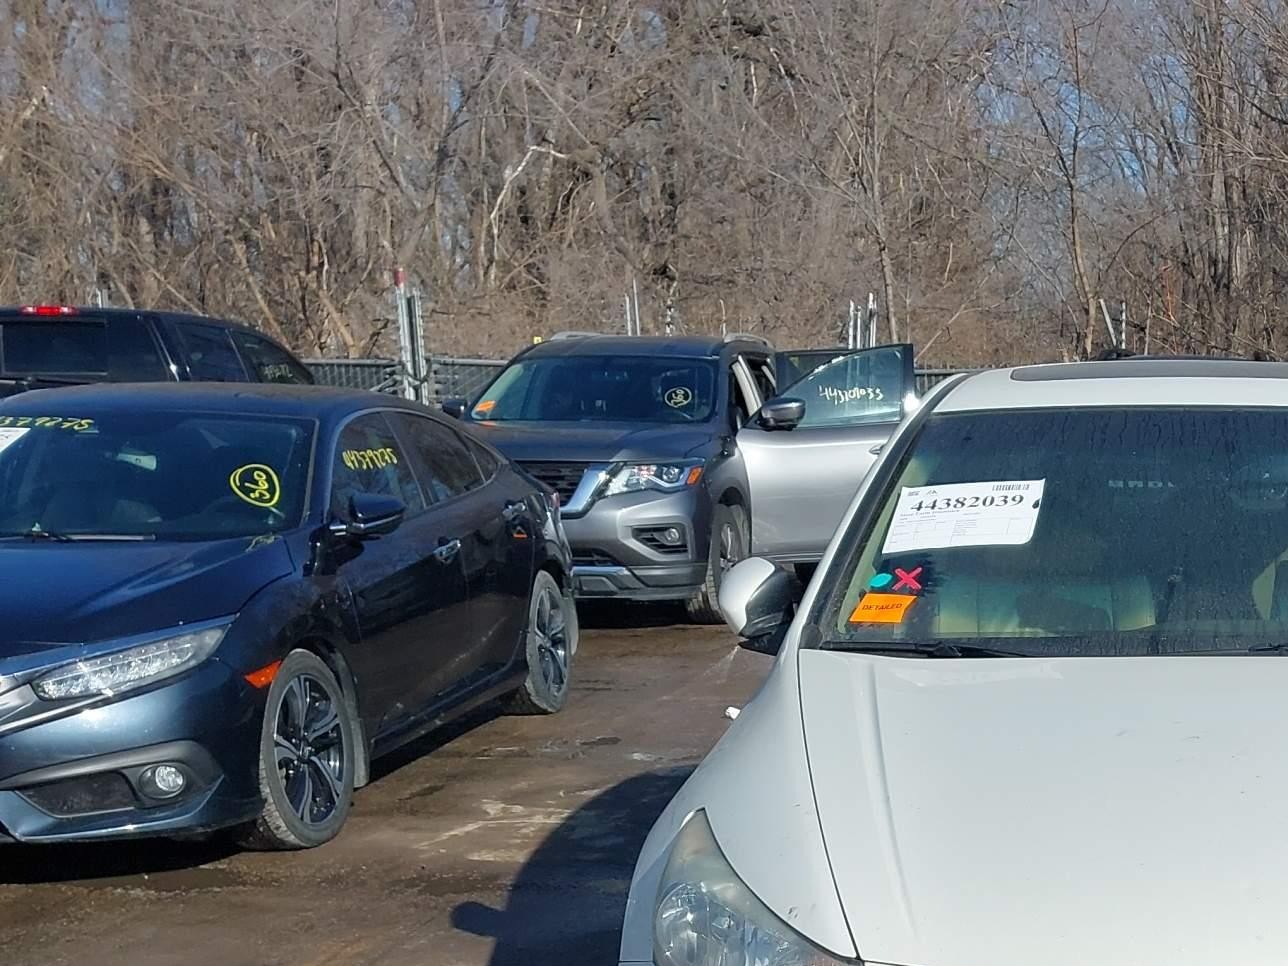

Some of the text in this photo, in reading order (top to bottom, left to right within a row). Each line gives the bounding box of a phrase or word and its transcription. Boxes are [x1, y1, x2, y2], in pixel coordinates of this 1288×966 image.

[244, 470, 270, 500] 360
[910, 494, 1025, 512] 44382039
[861, 603, 903, 611] DETAILED
